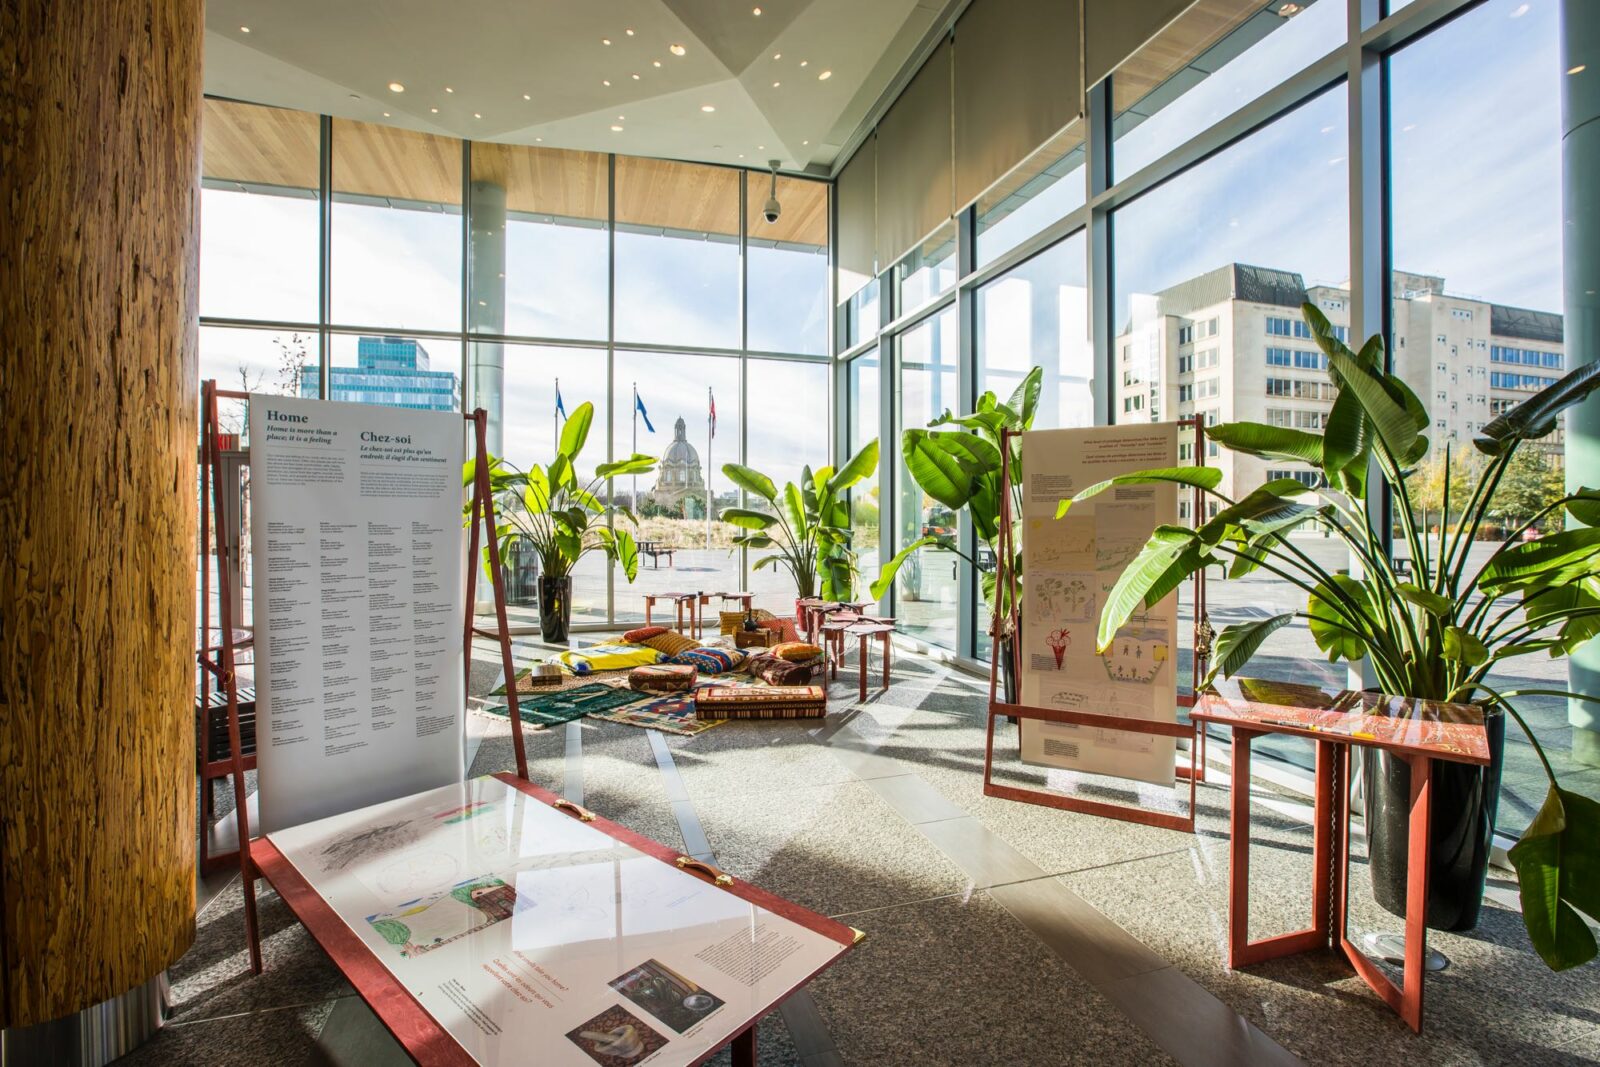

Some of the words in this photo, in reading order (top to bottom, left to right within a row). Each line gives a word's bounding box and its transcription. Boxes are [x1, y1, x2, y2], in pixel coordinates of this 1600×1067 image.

[267, 410, 309, 423] Home
[266, 425, 289, 433] Home
[308, 436, 332, 445] feeling
[360, 431, 412, 444] Chez-soi
